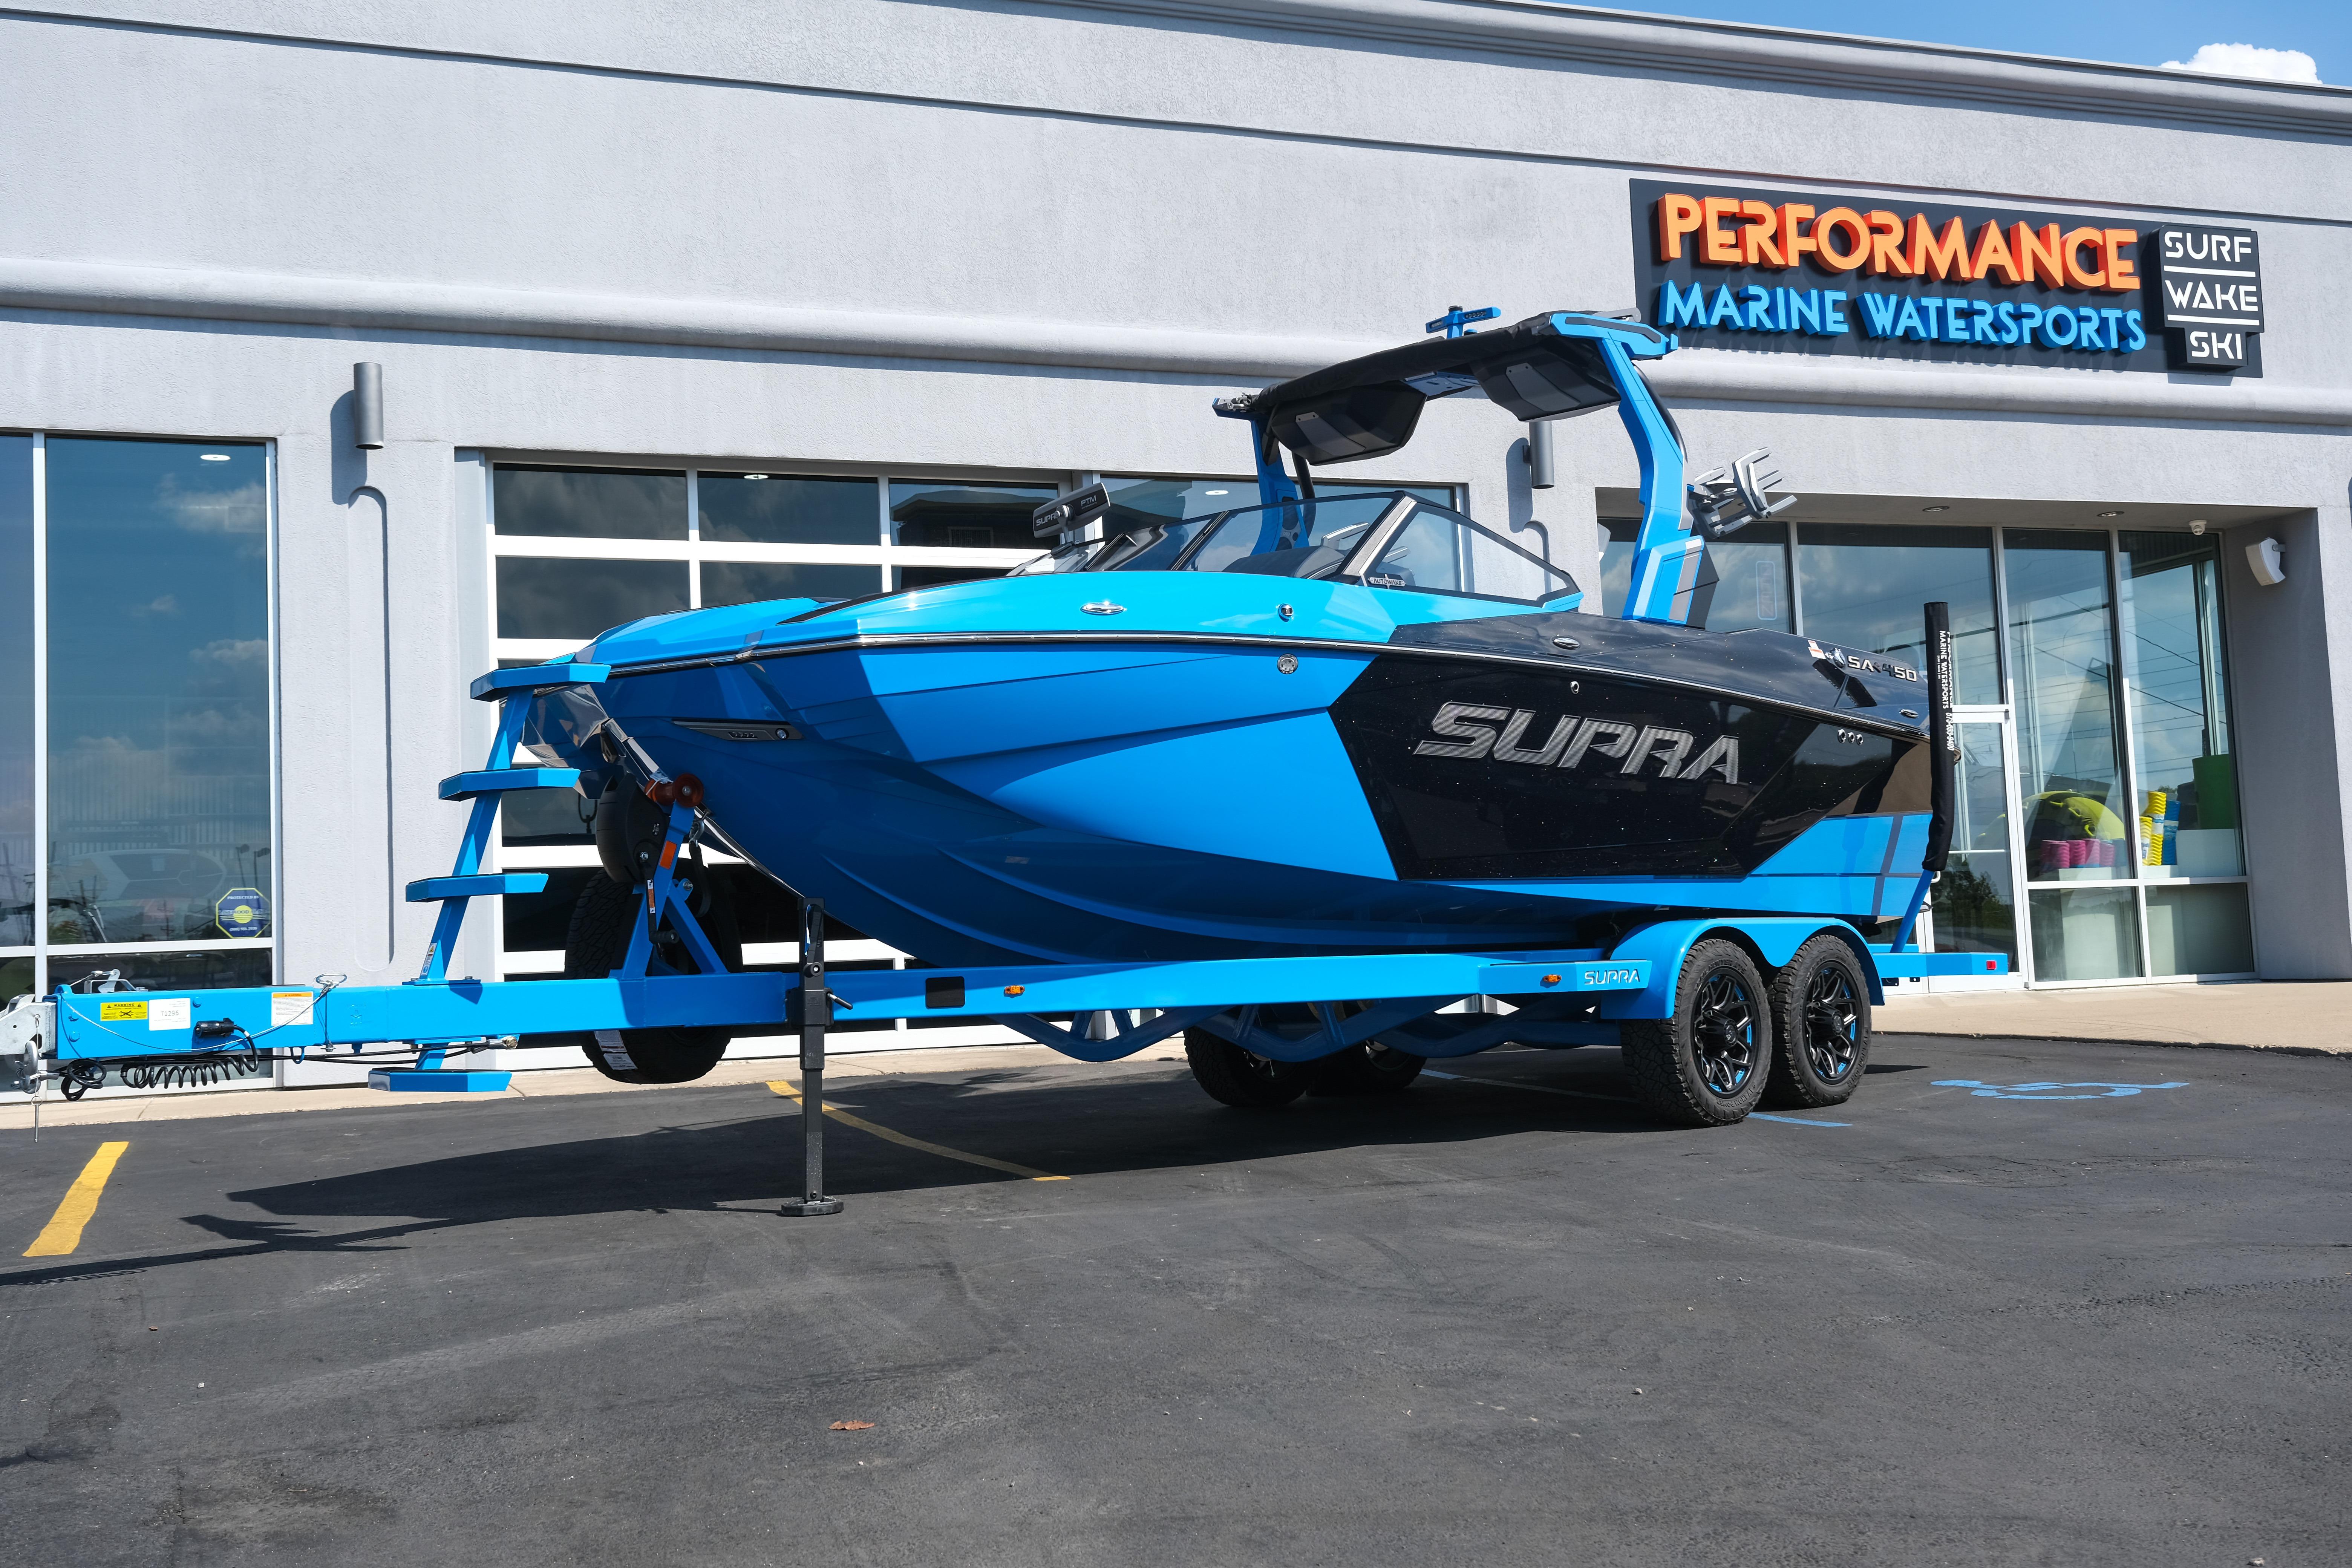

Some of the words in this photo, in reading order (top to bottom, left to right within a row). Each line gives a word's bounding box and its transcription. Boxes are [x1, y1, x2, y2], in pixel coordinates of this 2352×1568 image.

[1658, 193, 2141, 292] PERFORMANCE
[2164, 231, 2251, 262] SURF
[2165, 280, 2259, 312] WAKE
[1659, 280, 1849, 336] MARINE
[1856, 292, 2147, 354] WATERSPORTS
[2190, 331, 2243, 360] SKI
[1081, 495, 1096, 507] PTM
[1036, 513, 1057, 526] SUPR
[1848, 655, 1875, 672] SA
[1882, 663, 1917, 682] 450
[1941, 662, 1949, 709] WATERSPORTS
[1413, 701, 1740, 784] SUPRA
[1584, 969, 1640, 985] SUPRA
